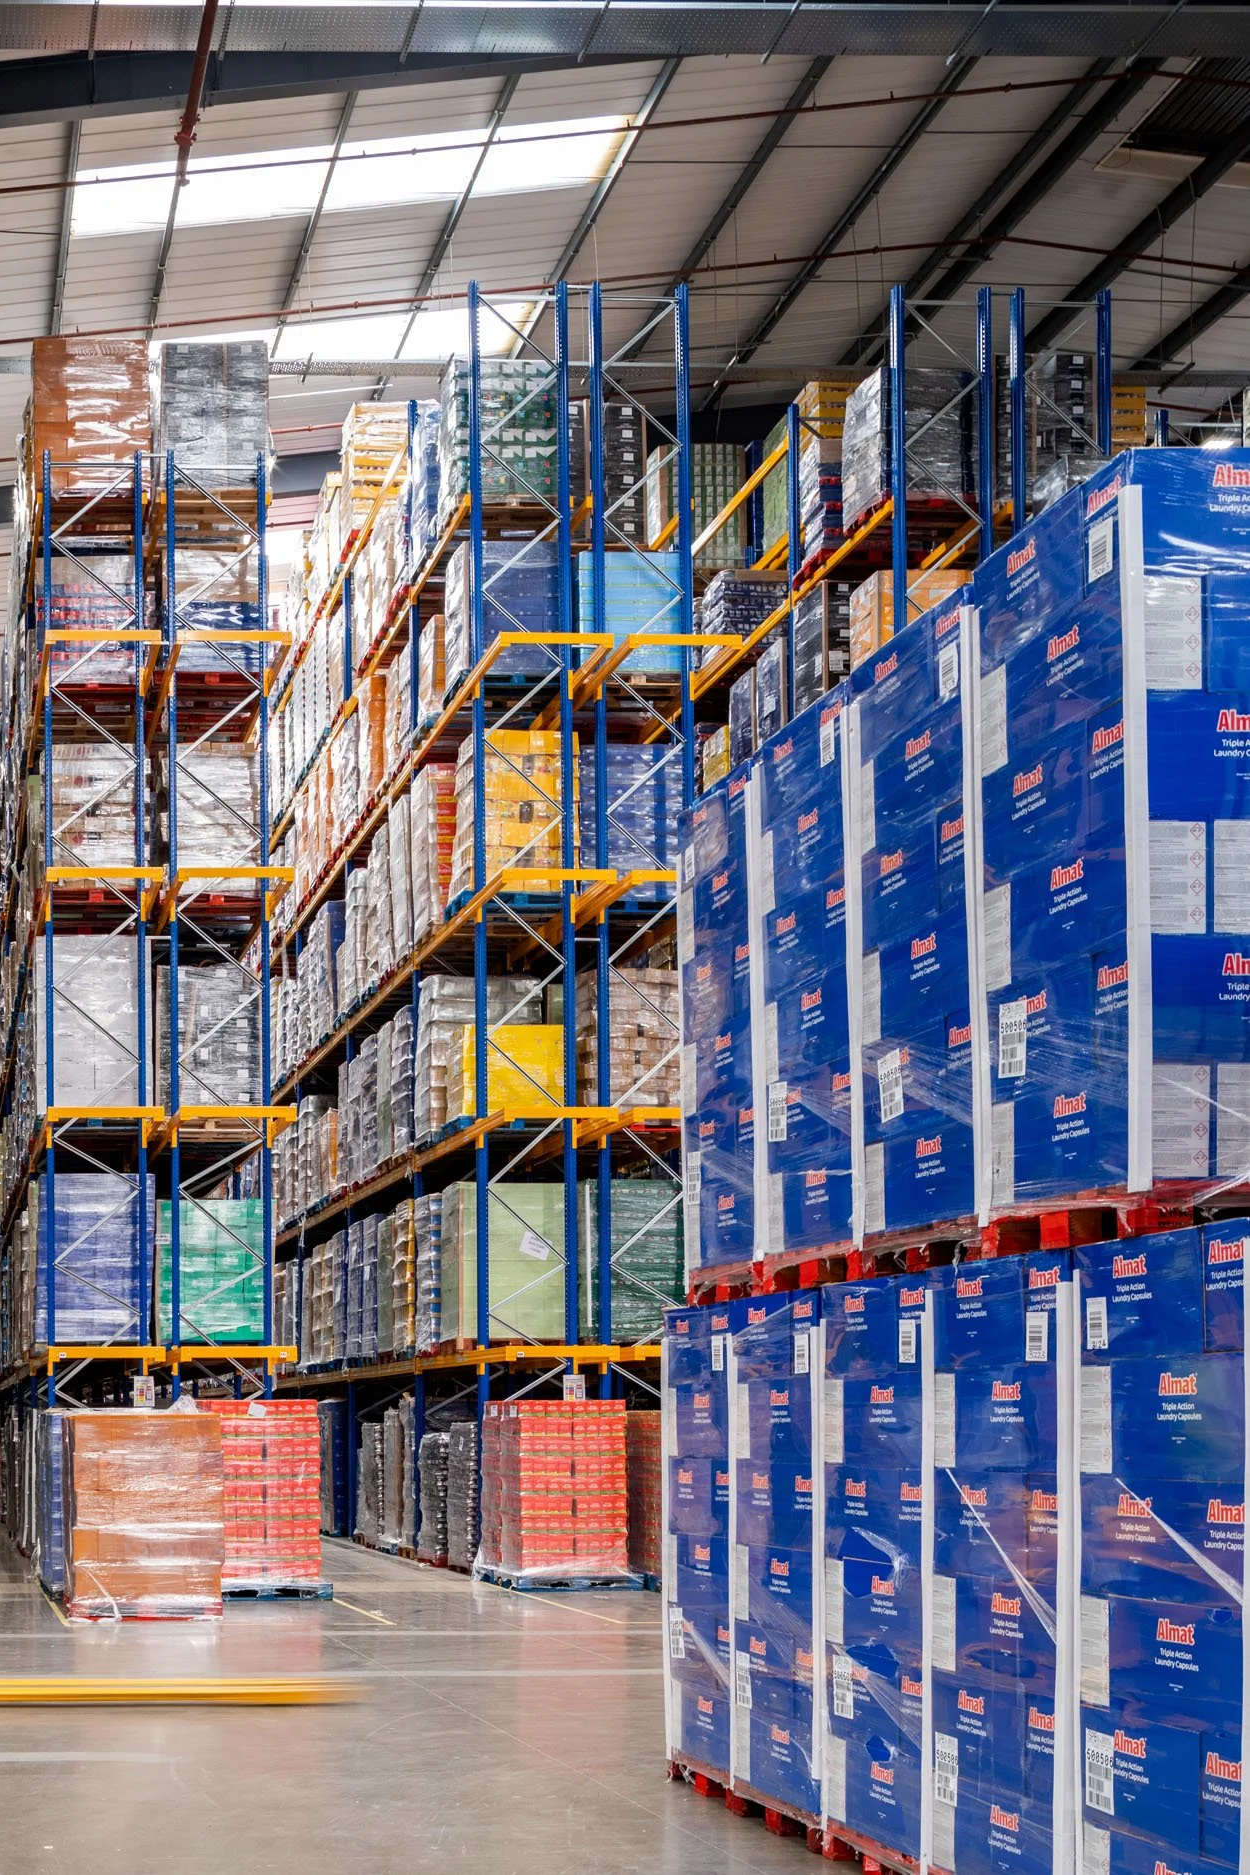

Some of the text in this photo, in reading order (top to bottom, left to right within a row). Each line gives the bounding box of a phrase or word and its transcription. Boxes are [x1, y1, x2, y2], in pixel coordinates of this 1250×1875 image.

[1213, 464, 1250, 487] Alm
[1087, 476, 1121, 517] Almat
[1218, 494, 1238, 505] Triple
[1210, 504, 1239, 513] Laundry
[1007, 540, 1035, 577] Almat
[1047, 625, 1079, 661] Almat
[875, 653, 897, 683] Almat
[820, 699, 842, 727] Almat
[1216, 708, 1250, 732] Alm
[906, 730, 930, 760] Almat
[1222, 739, 1244, 749] Triple
[1214, 749, 1244, 759] Laundry
[1013, 764, 1042, 796] Almat
[798, 811, 817, 832] Almat
[880, 850, 903, 875] Almat
[1051, 859, 1083, 890] Almat
[827, 887, 845, 908] Alma
[1054, 887, 1081, 903] Triple Action
[1049, 901, 1066, 914] Laundry
[777, 914, 796, 934] Almat
[911, 933, 936, 959] Almat
[1228, 982, 1249, 993] Triple
[801, 990, 821, 1010] Almat
[1219, 993, 1250, 1003] Laundry
[1001, 1020, 1027, 1034] 500506
[832, 1073, 851, 1092] Alma
[1054, 1093, 1086, 1117] Almat
[1056, 1120, 1084, 1131] Triple Action
[1052, 1132, 1069, 1142] Laundry
[916, 1136, 941, 1158] Almat
[806, 1168, 827, 1188] Almat
[718, 1195, 734, 1211] Almat
[1113, 1255, 1147, 1278] Almat
[1211, 1271, 1224, 1280] Triple
[1029, 1267, 1060, 1289] Almat
[1206, 1280, 1227, 1291] Laundry
[900, 1288, 925, 1307] Almat
[957, 1278, 982, 1298] Almat
[1116, 1283, 1145, 1293] Triple Action
[844, 1295, 864, 1313] Almat
[1112, 1294, 1130, 1303] Laundry
[748, 1308, 766, 1324] Almat
[793, 1302, 812, 1319] Almat
[992, 1381, 1020, 1401] Almat
[1159, 1374, 1197, 1396] Almat
[770, 1390, 789, 1406] Almat
[870, 1386, 893, 1404] Almat
[1162, 1403, 1177, 1412] Triple
[1157, 1413, 1202, 1422] Laundry Capsules
[795, 1476, 813, 1493] Alma
[845, 1479, 866, 1498] Almat
[961, 1485, 986, 1506] Almat
[1032, 1490, 1058, 1511] Alma
[1117, 1494, 1151, 1518] Almat
[1120, 1523, 1150, 1532] Triple Action
[1210, 1531, 1225, 1540] Triple
[1115, 1533, 1134, 1542] Laundry
[1204, 1541, 1225, 1551] Laundry
[770, 1558, 789, 1576] Almat
[871, 1576, 894, 1596] Almat
[991, 1593, 1021, 1617] Almat
[1157, 1618, 1194, 1646] Almat
[1159, 1648, 1192, 1660] Triple Action
[1155, 1658, 1199, 1672] Laundry Capsules
[901, 1676, 922, 1697] Alma
[958, 1691, 984, 1714] Almat
[1113, 1730, 1146, 1759] Almat
[1086, 1749, 1113, 1768] 500506
[1115, 1758, 1143, 1772] Triple Action
[871, 1762, 894, 1785] Almat
[1112, 1768, 1128, 1780] aundry
[1208, 1782, 1222, 1793] Triple
[1202, 1792, 1222, 1805] Laundry
[990, 1806, 1018, 1832] Almat
